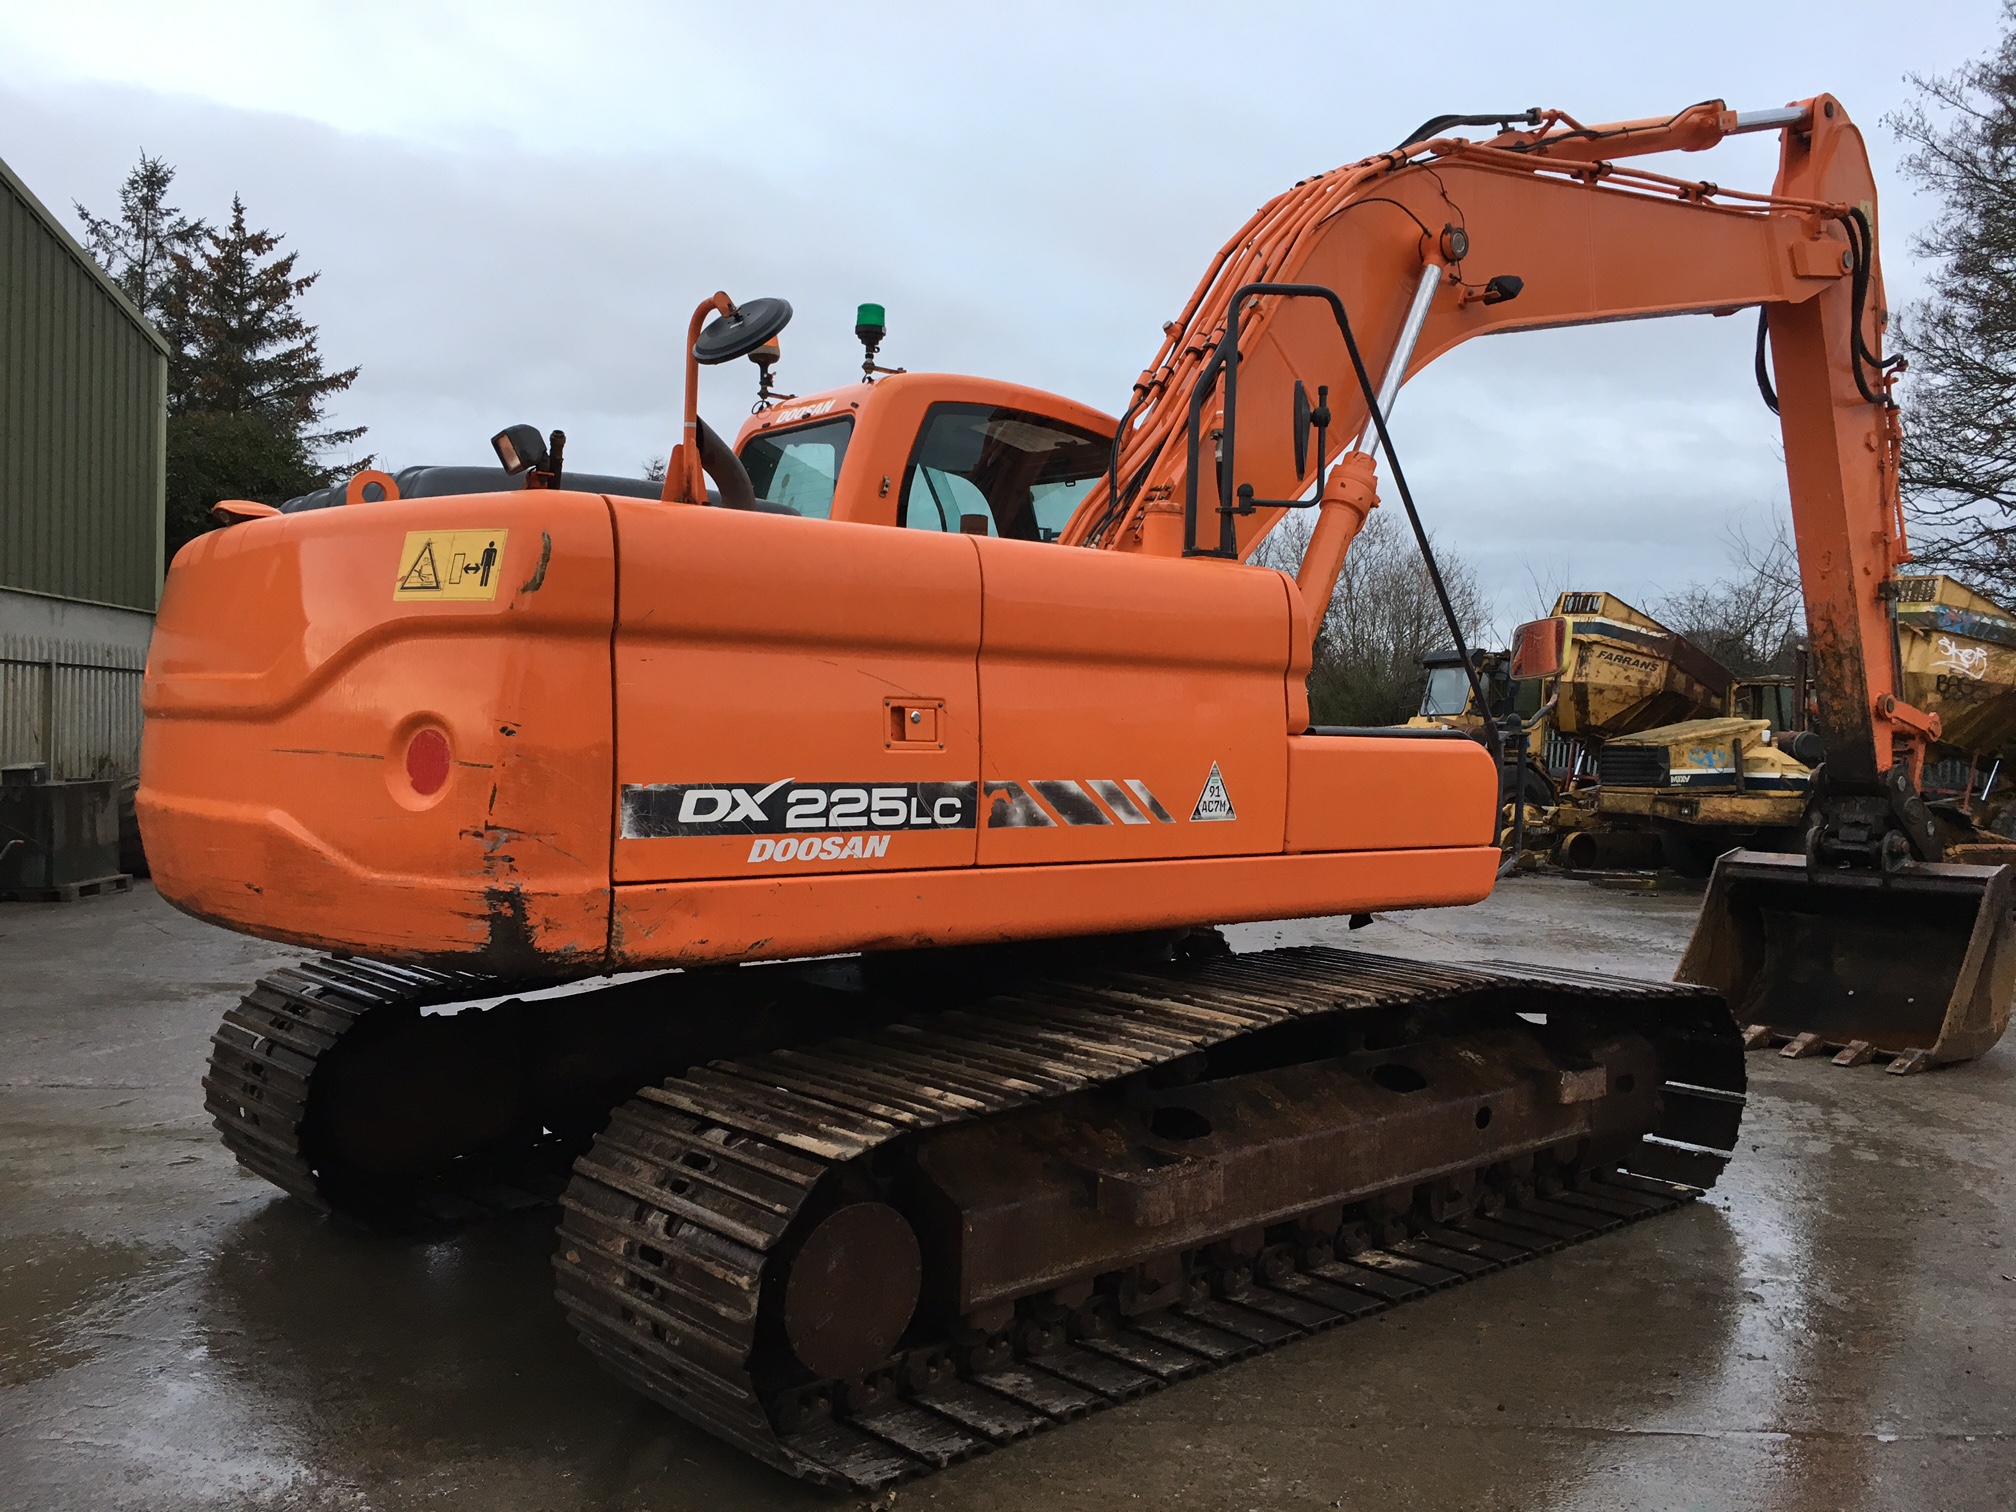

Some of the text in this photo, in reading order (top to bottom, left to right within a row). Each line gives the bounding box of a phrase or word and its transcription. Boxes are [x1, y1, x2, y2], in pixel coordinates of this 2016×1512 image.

[775, 399, 836, 424] DOOSAN
[1596, 650, 1659, 672] FARRANS
[678, 777, 796, 823] DX
[1209, 785, 1221, 797] 91
[1202, 800, 1226, 812] AC7M
[747, 834, 892, 863] DOOSAN
